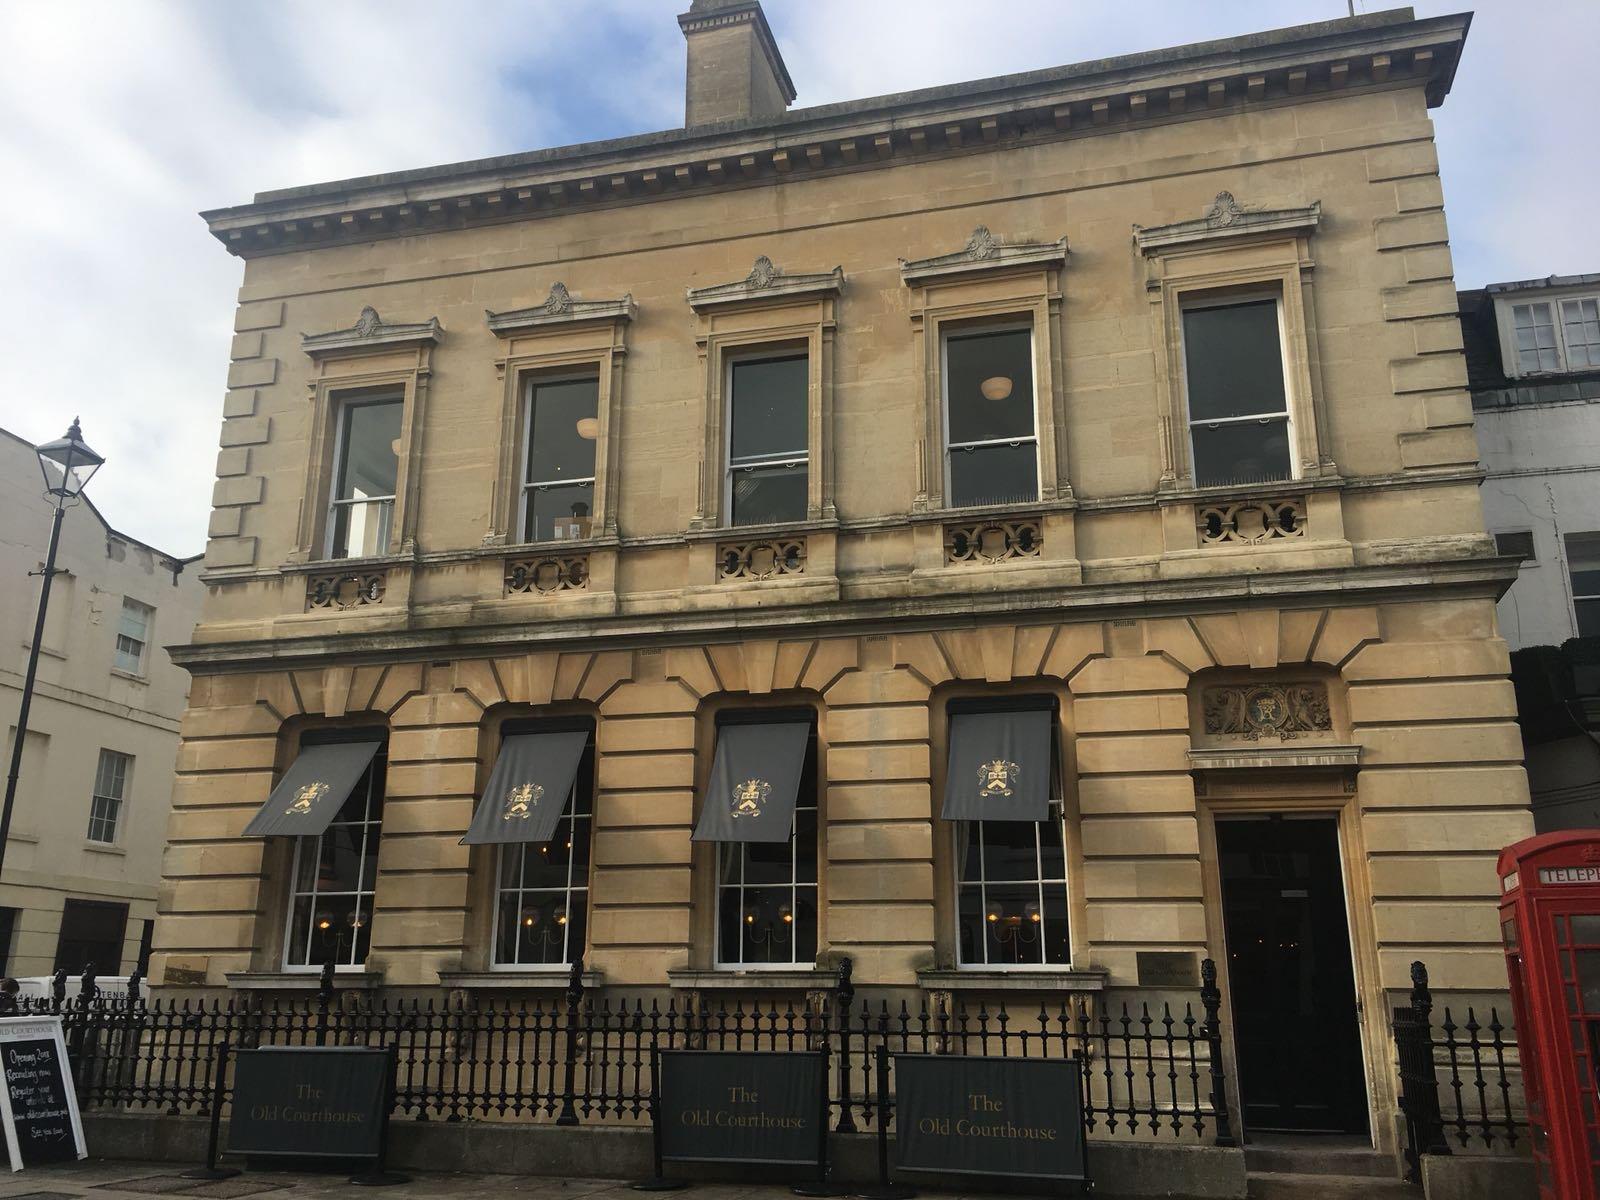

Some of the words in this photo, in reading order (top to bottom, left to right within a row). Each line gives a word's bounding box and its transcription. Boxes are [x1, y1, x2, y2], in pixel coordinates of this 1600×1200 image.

[296, 1084, 323, 1100] The
[728, 1086, 760, 1103] The
[968, 1093, 1003, 1112] The
[251, 1106, 278, 1121] Old
[282, 1106, 365, 1123] Courthouse
[681, 1109, 710, 1127] Old
[715, 1110, 807, 1128] Courthouse
[919, 1117, 950, 1136] Old
[956, 1119, 1057, 1140] Courthouse
